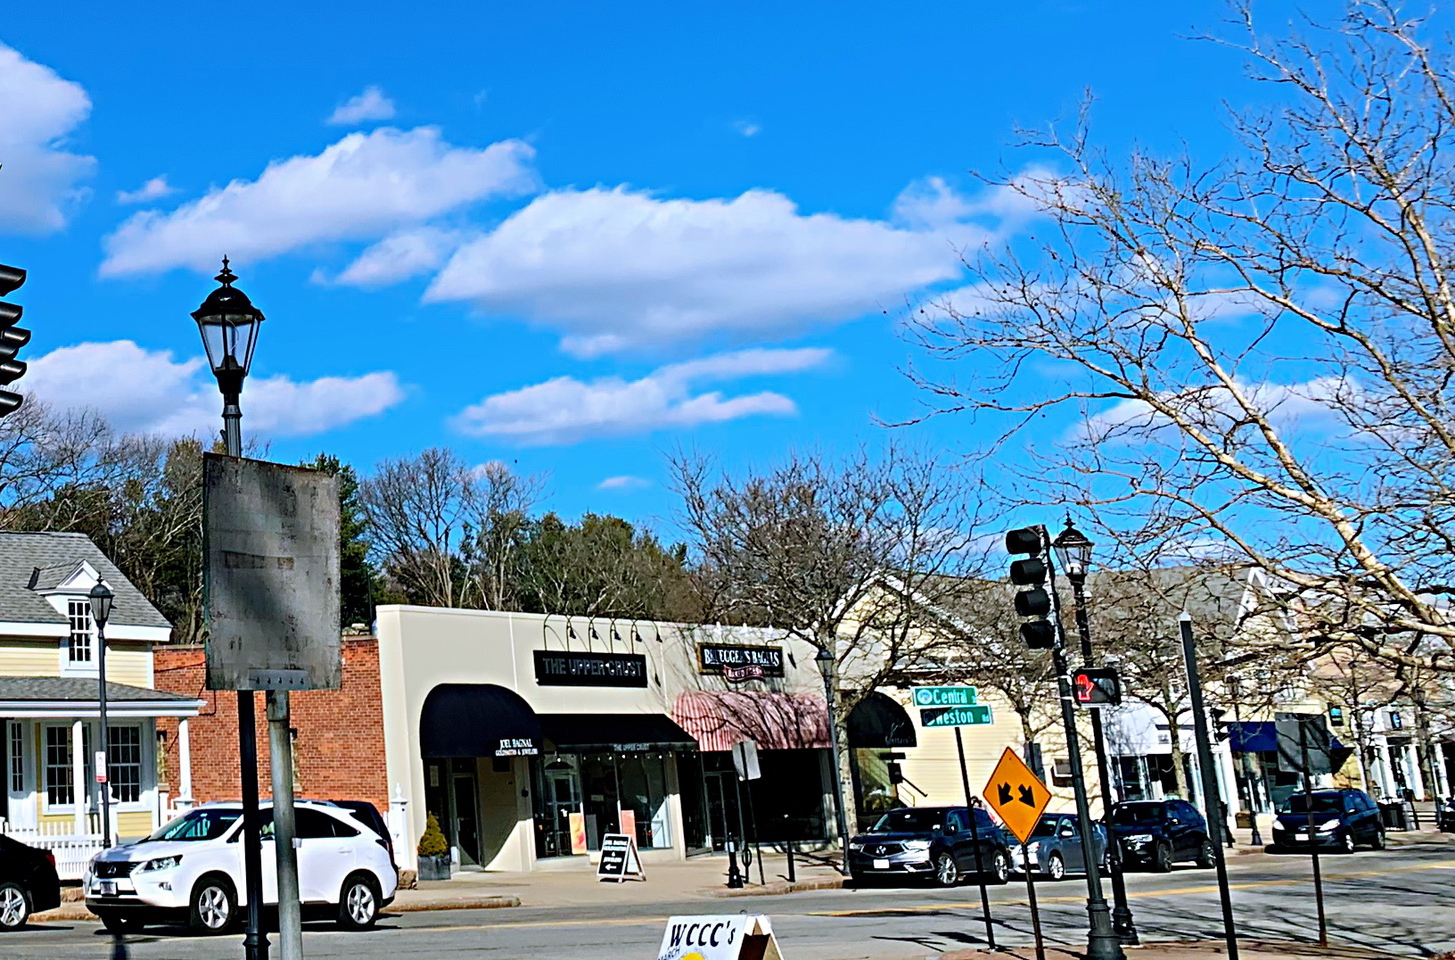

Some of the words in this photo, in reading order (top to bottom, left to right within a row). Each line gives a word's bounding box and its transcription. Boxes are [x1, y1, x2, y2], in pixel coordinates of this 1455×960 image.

[543, 658, 566, 674] THE
[569, 659, 605, 676] UPPER
[606, 660, 642, 677] CRUST
[933, 689, 967, 704] Central
[935, 709, 974, 725] Weston
[499, 739, 511, 750] JOEL
[670, 920, 736, 947] WCCC's
